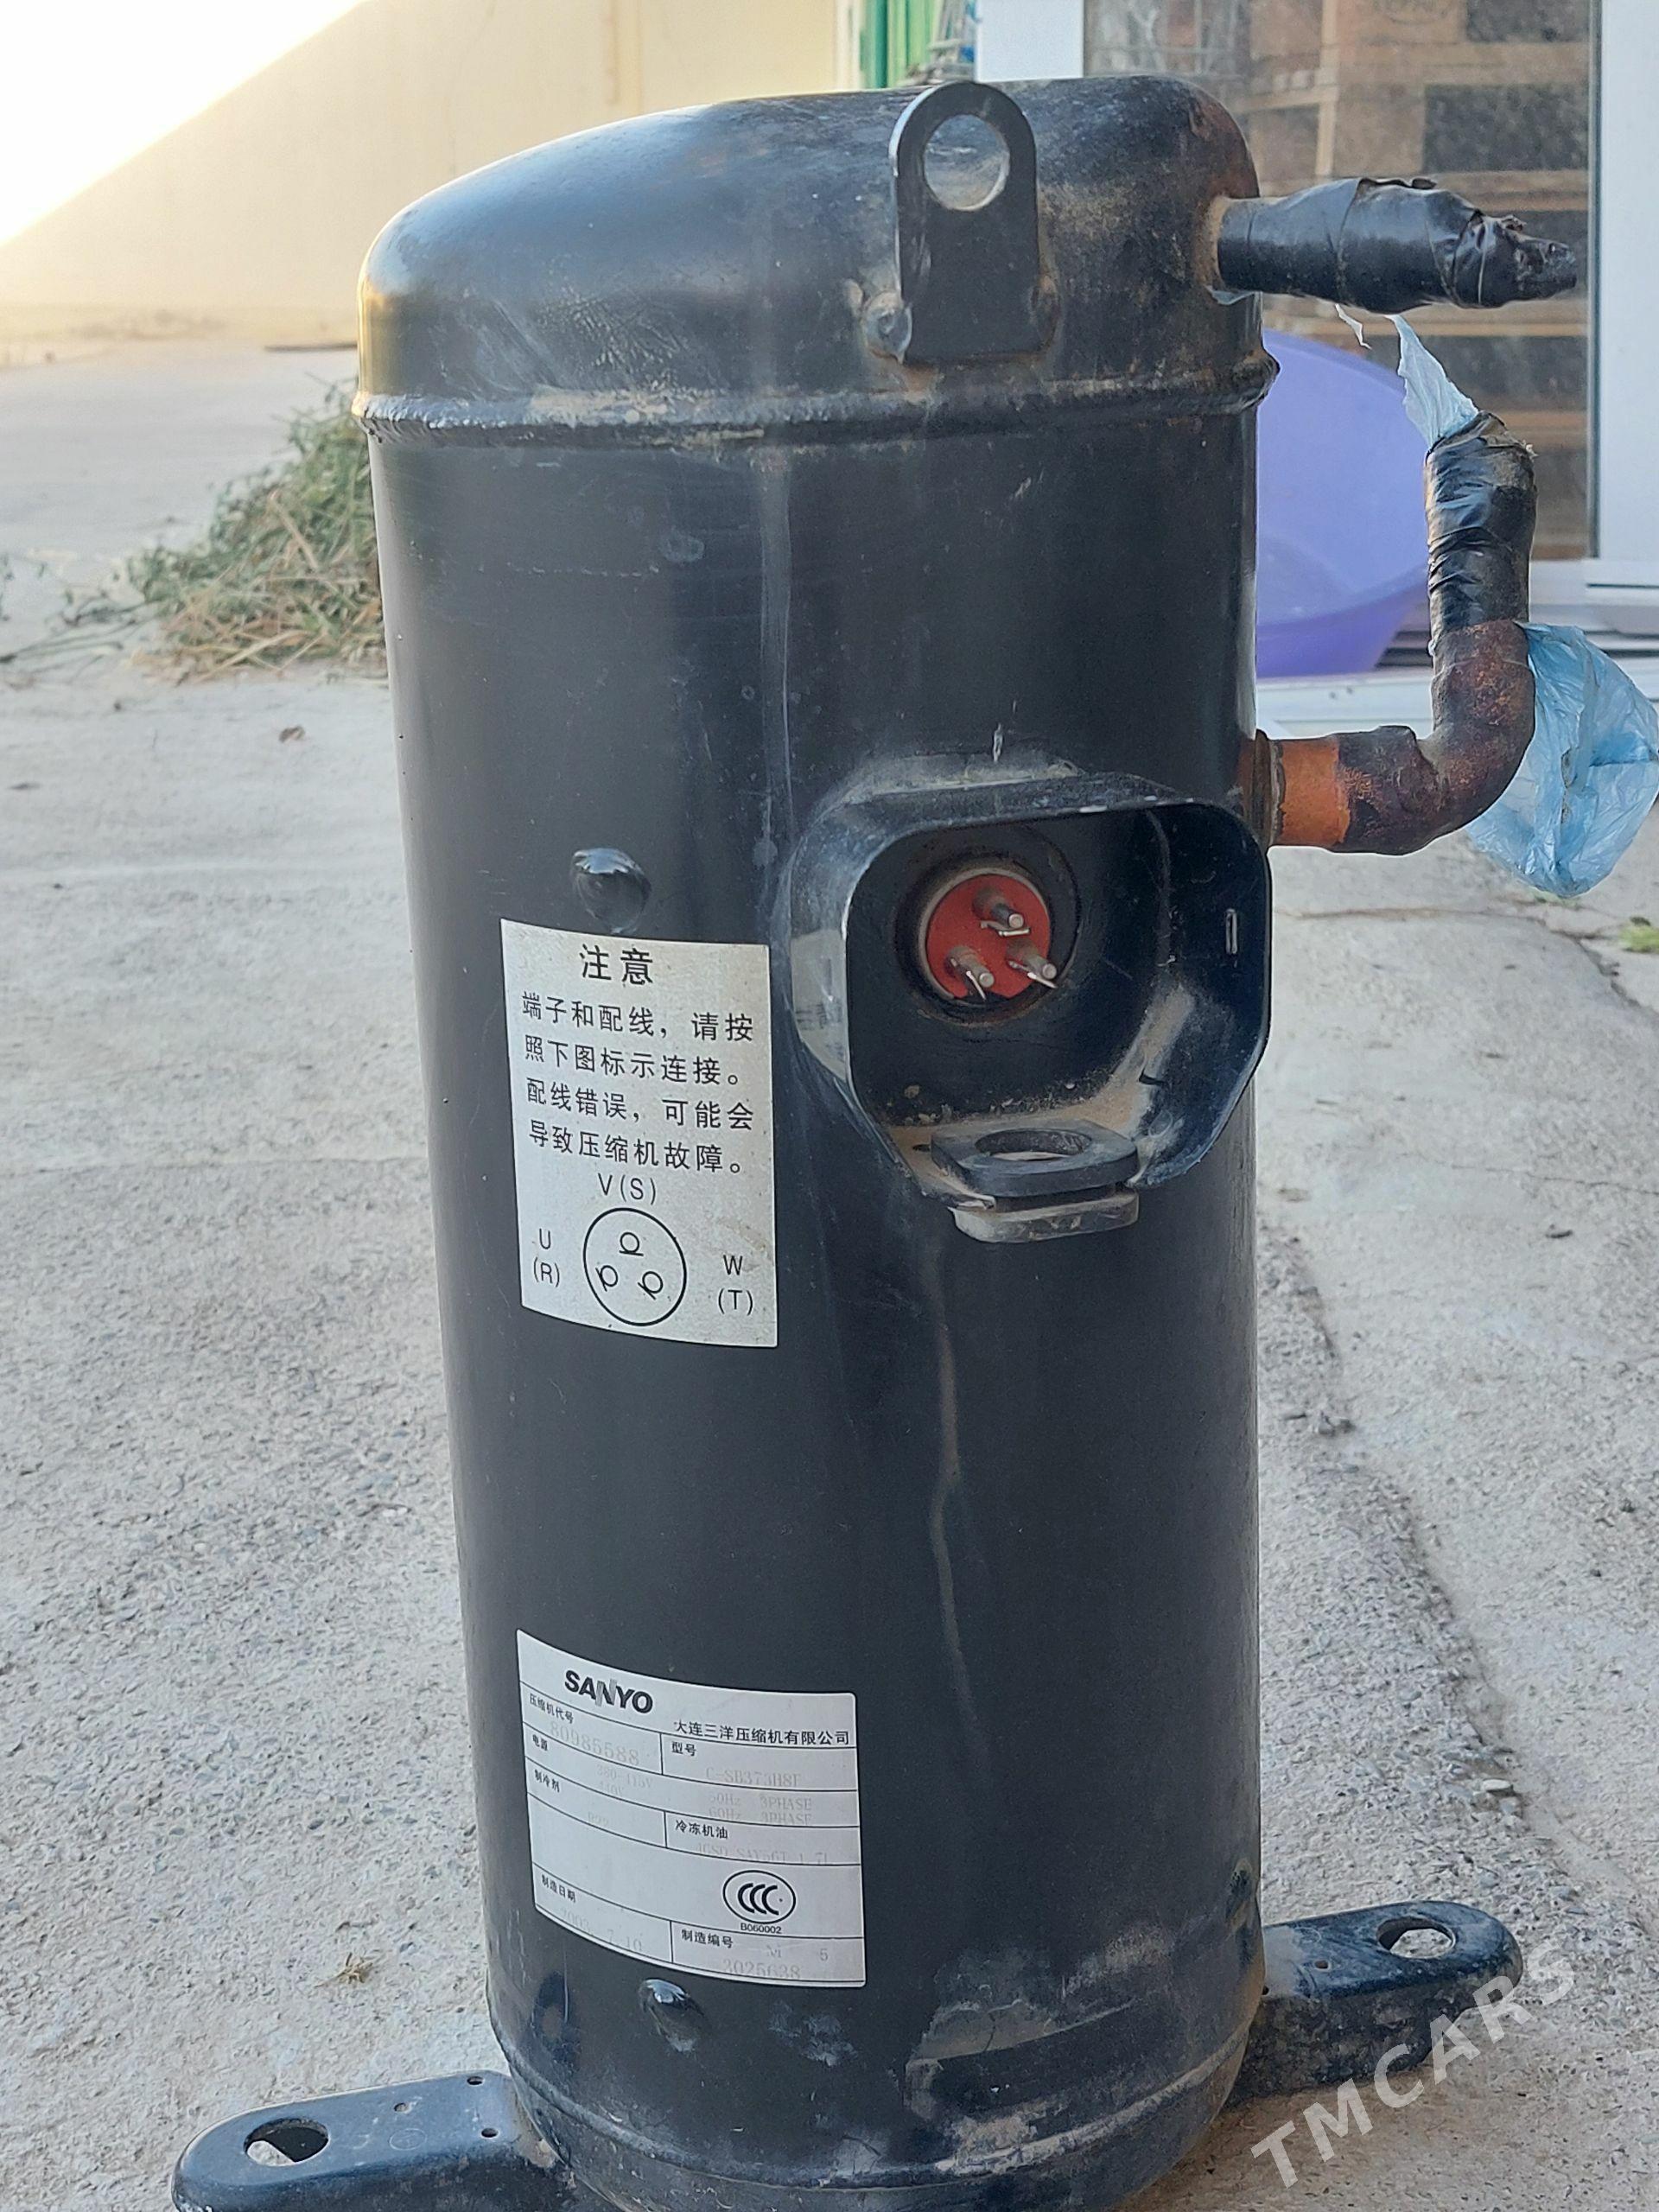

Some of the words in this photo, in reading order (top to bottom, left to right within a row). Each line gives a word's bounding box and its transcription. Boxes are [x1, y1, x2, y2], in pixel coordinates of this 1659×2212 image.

[580, 944, 654, 985] 注意
[522, 992, 753, 1042] 端子和配线，请按
[524, 1034, 739, 1086] 照下图标示连接。
[527, 1077, 753, 1131] 配线错误，可能会
[529, 1119, 741, 1174] 导致压缩机故障。
[598, 1173, 656, 1205] V(S)
[538, 1228, 551, 1250] U
[533, 1257, 560, 1288] (R)
[723, 1255, 743, 1276] W
[718, 1288, 753, 1316] (T)
[564, 1669, 654, 1714] SANYO
[529, 1693, 575, 1725] 压缩机代号
[674, 1719, 850, 1745] 大连三洋压缩机有限公司
[671, 1741, 696, 1757] 型号
[675, 1821, 728, 1840] 冷冻机油
[681, 1929, 734, 1949] 制造编号
[741, 1923, 783, 1935] B060002
